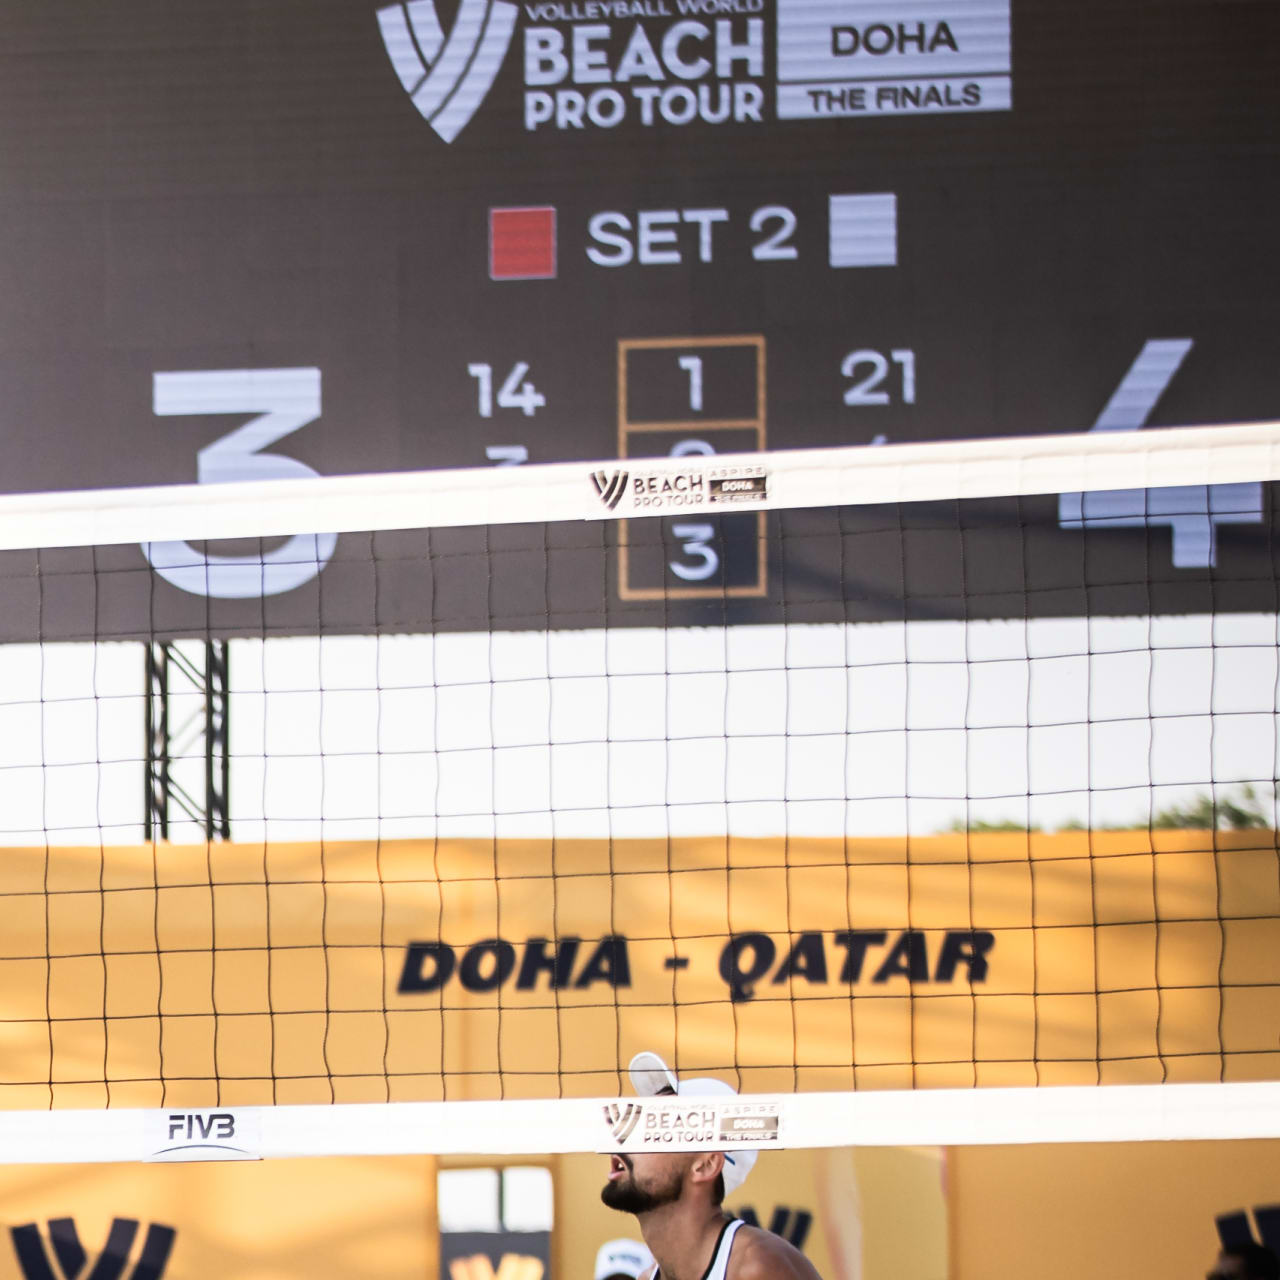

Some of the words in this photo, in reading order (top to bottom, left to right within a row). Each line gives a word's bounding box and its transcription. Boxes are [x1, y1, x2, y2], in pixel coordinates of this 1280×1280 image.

[526, 1, 671, 21] VOLLEYBALL
[678, 0, 764, 16] WORLD
[524, 18, 765, 86] BEACH
[831, 21, 959, 57] DOHA
[525, 87, 626, 130] PRO
[632, 82, 764, 127] TOUR
[807, 88, 866, 113] THE
[875, 83, 982, 110] FINALS
[586, 208, 729, 267] SET
[749, 205, 798, 261] 2
[468, 361, 546, 418] 14
[678, 356, 704, 411] 1
[841, 349, 916, 405] 21
[140, 367, 338, 599] 3
[633, 474, 704, 495] BEACH
[633, 497, 663, 508] PRO
[665, 494, 704, 506] TOUR
[669, 523, 720, 582] 3
[396, 932, 632, 994] DOHA
[718, 931, 995, 1003] QATAR
[168, 1113, 235, 1139] FIVB
[644, 1132, 673, 1143] PRO
[675, 1131, 714, 1143] TOUR
[646, 1112, 715, 1128] BEACH
